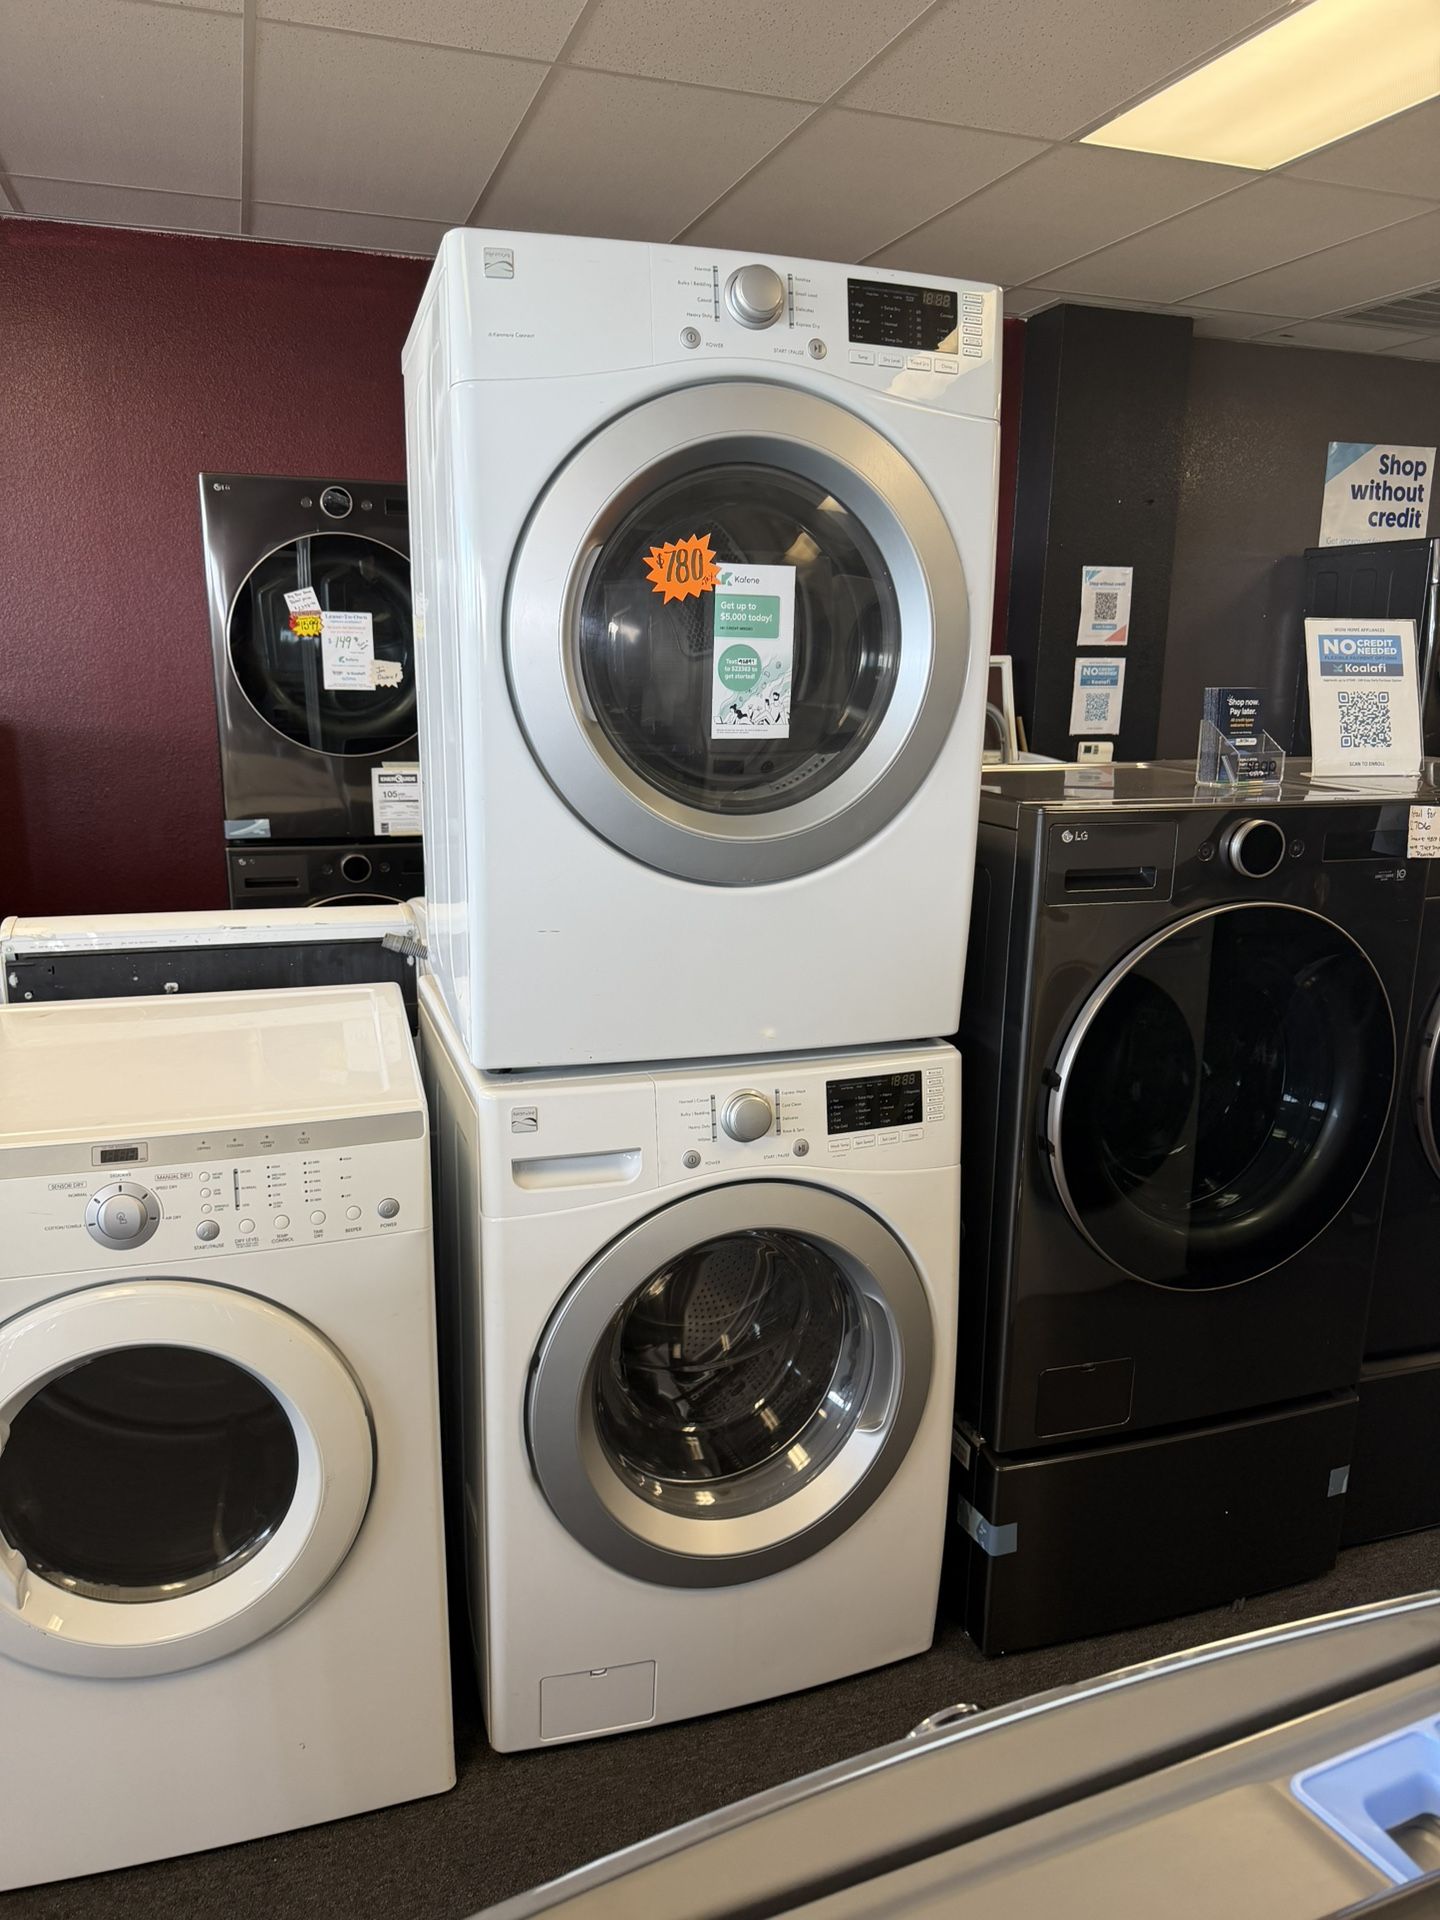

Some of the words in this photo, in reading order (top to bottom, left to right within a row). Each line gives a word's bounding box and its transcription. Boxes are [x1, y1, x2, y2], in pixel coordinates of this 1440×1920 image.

[1379, 454, 1427, 481] Shop
[1351, 479, 1424, 502] without
[1368, 507, 1421, 528] credit
[735, 576, 760, 584] Kafene
[720, 601, 735, 610] Get
[736, 603, 747, 612] up
[720, 613, 747, 622] $5,000
[748, 614, 773, 624] today!
[1323, 639, 1357, 655] NO
[1357, 639, 1393, 647] CREDIT
[1083, 667, 1098, 676] NO
[1345, 664, 1387, 673] Koalafi
[1228, 699, 1245, 707] Shop
[1230, 708, 1241, 716] Pay
[383, 790, 398, 798] 105
[1075, 831, 1089, 841] LG
[51, 1183, 72, 1191] SENSOR
